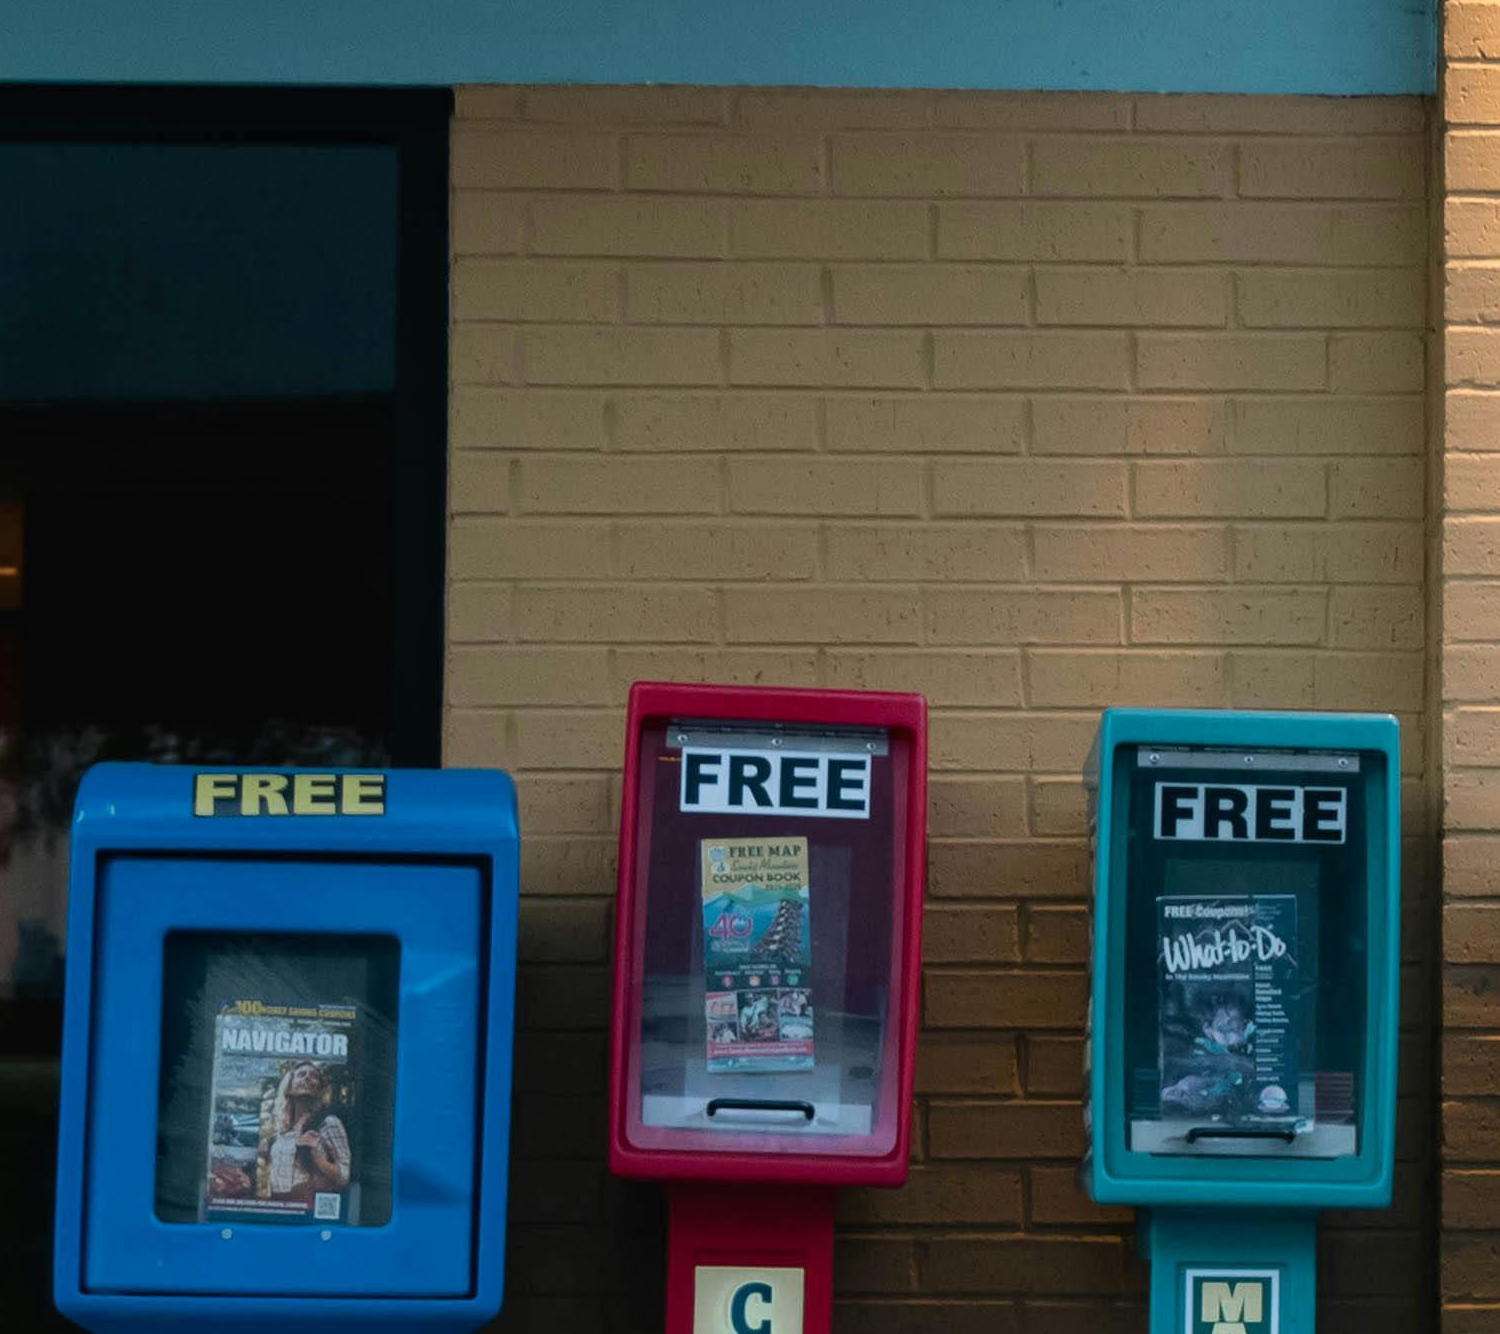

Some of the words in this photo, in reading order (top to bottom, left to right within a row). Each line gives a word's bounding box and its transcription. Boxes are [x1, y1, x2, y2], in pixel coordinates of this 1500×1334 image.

[194, 773, 385, 816] FREE
[684, 753, 867, 811] FREE
[1160, 785, 1342, 841] FREE
[729, 845, 764, 858] FREE
[768, 844, 801, 857] MAP
[713, 873, 763, 884] COUPON
[767, 872, 801, 882] BOOK
[1164, 905, 1192, 918] FREE
[222, 1027, 348, 1056] NAVIGATOR
